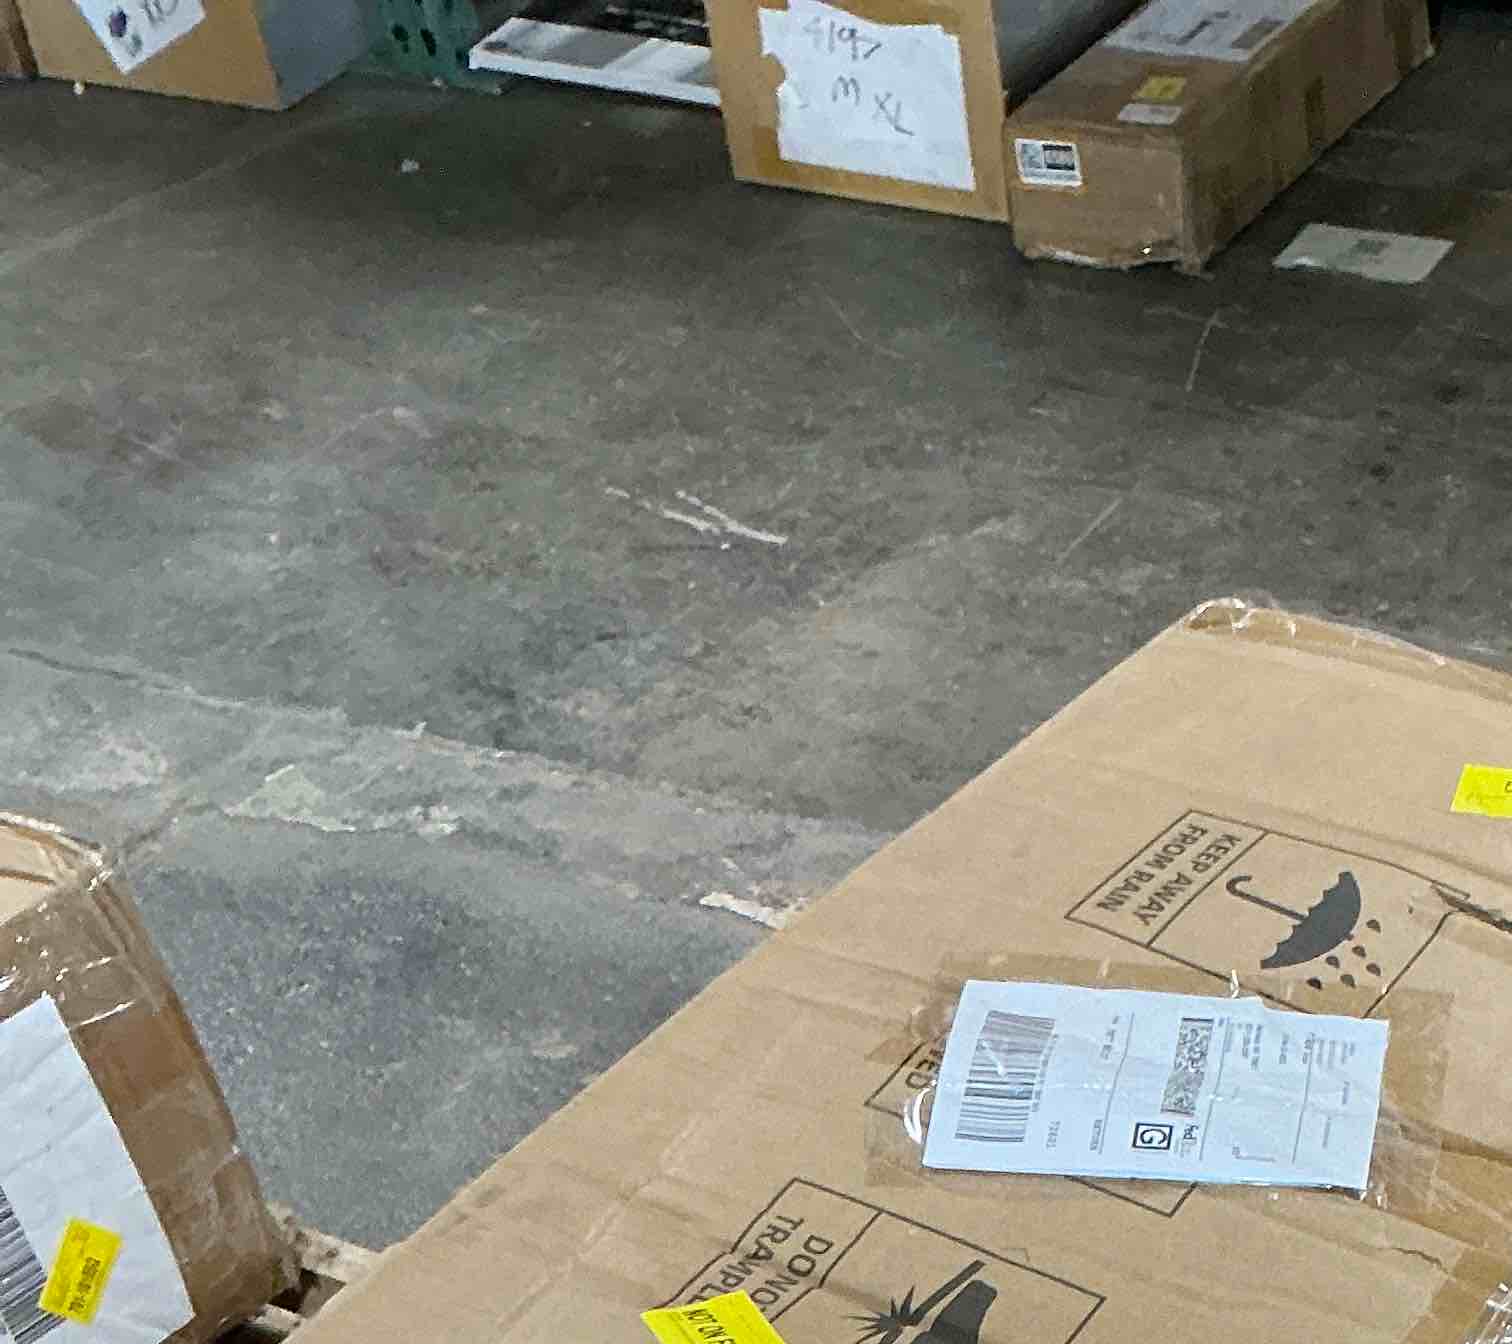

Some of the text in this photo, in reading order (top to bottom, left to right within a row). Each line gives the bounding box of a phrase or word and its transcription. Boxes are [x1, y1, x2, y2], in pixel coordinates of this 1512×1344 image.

[1096, 823, 1208, 913] FROM RAIN
[1132, 833, 1243, 926] KEEP AWAY
[1140, 1128, 1168, 1145] G
